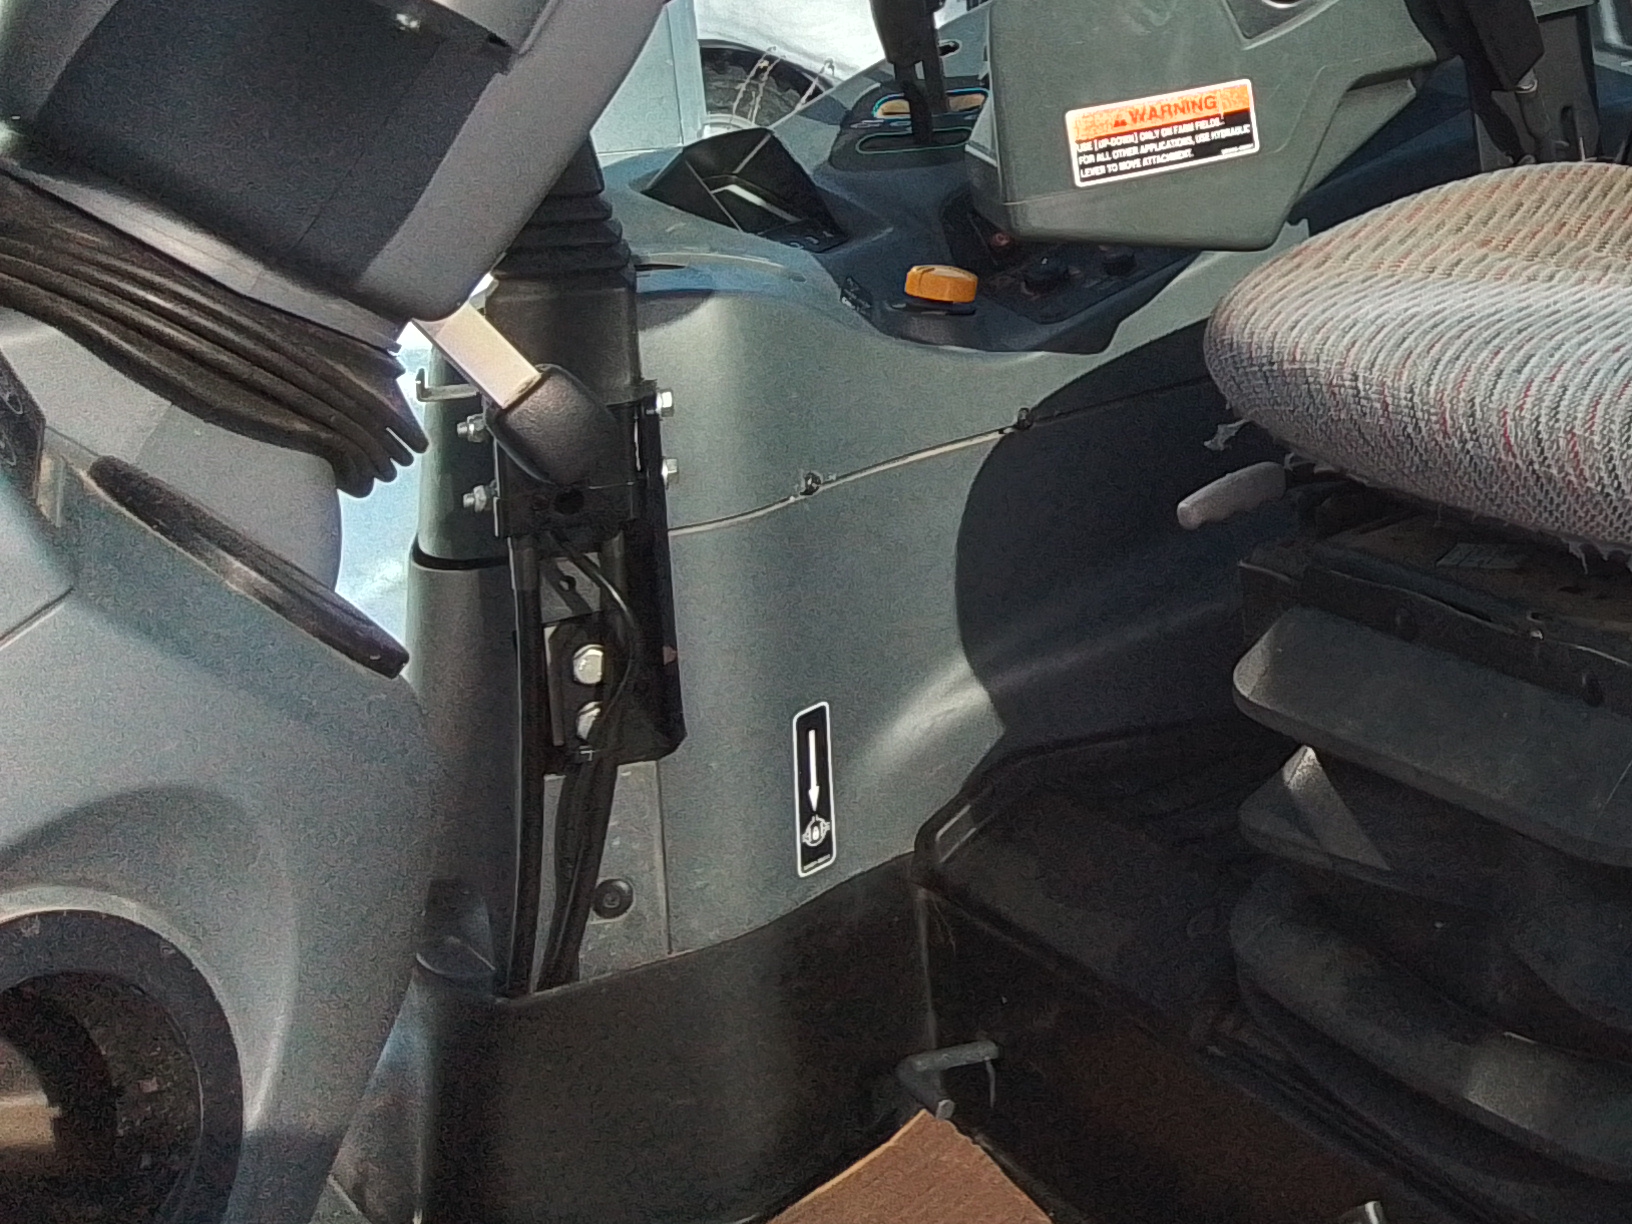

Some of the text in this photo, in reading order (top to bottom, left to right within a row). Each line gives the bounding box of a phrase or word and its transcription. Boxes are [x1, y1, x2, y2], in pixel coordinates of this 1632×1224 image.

[1128, 95, 1217, 123] WARNING
[1076, 141, 1093, 152] USE
[1138, 128, 1160, 141] ONLY
[1172, 122, 1194, 134] FARM
[1078, 154, 1095, 165] FOR
[1095, 150, 1112, 162] ALL
[1111, 145, 1139, 159] OTHER
[1080, 164, 1106, 178] LEVER
[1106, 162, 1118, 172] TO
[1118, 157, 1142, 170] MOVE
